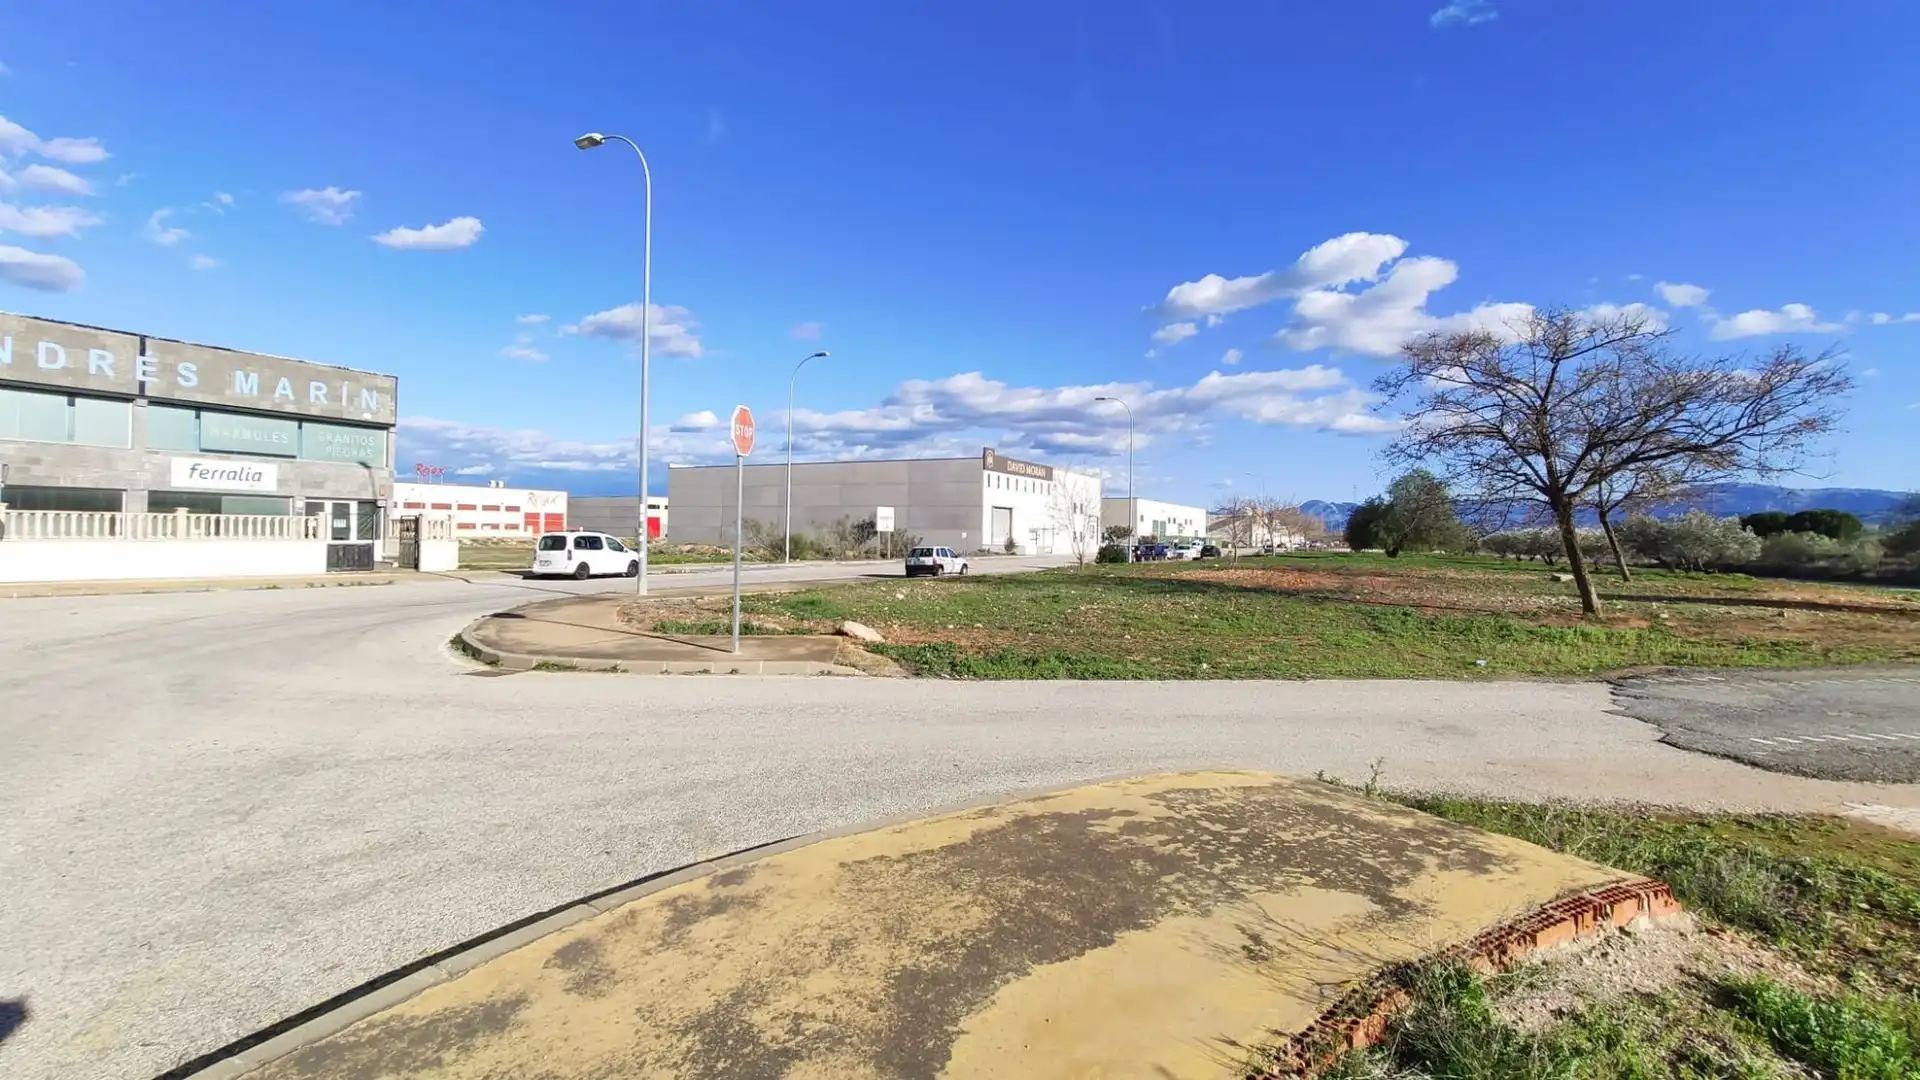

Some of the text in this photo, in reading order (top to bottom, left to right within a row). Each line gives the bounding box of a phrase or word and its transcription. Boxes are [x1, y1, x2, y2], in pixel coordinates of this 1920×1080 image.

[235, 370, 378, 410] MARÍN
[735, 423, 753, 438] STOP
[318, 431, 375, 446] GRANITOS
[189, 463, 263, 482] ferralia
[1007, 460, 1026, 474] DAVID
